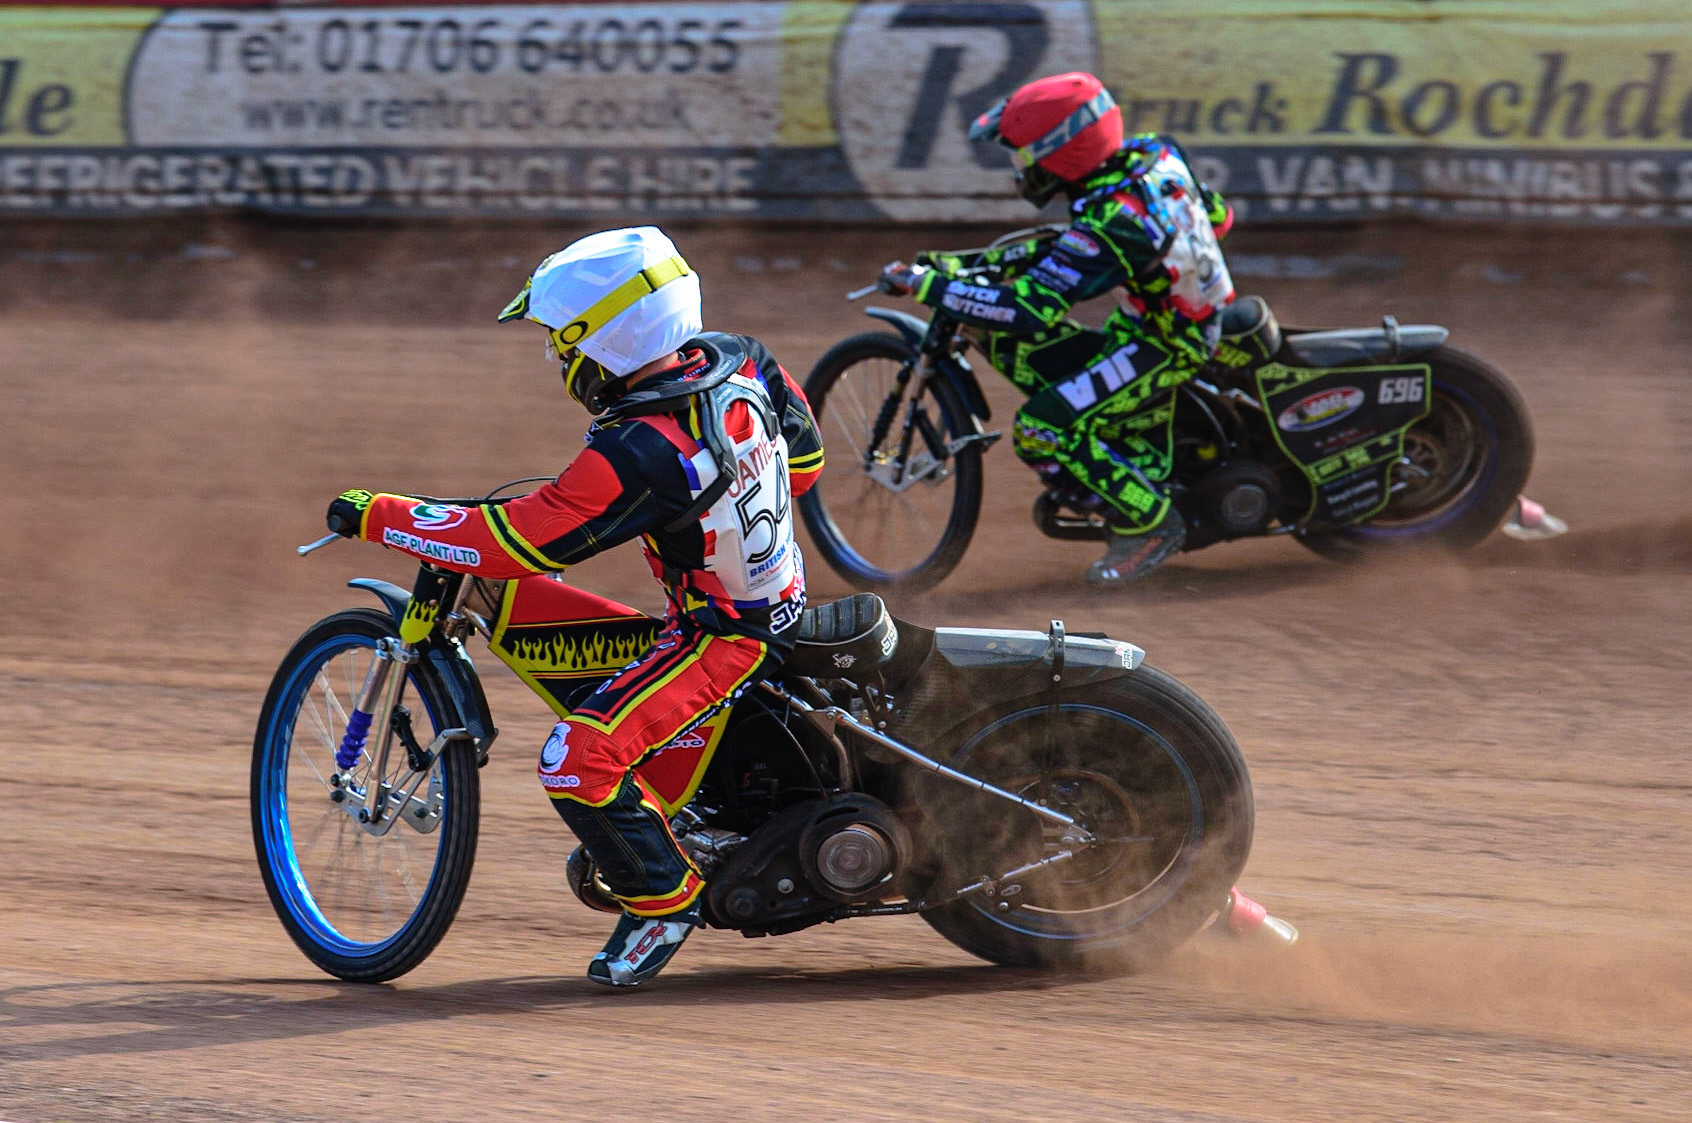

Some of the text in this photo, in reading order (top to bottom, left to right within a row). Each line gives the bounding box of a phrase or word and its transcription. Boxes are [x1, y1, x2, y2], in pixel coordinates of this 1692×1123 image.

[317, 18, 501, 74] 01706
[516, 18, 744, 74] 640055
[1310, 52, 1692, 139] Rochd
[383, 154, 620, 211] VEHICLE
[629, 155, 759, 211] HIRE
[1378, 377, 1424, 404] 696
[410, 538, 450, 560] PLANT
[453, 549, 478, 564] LTD
[750, 544, 786, 578] BRITISH
